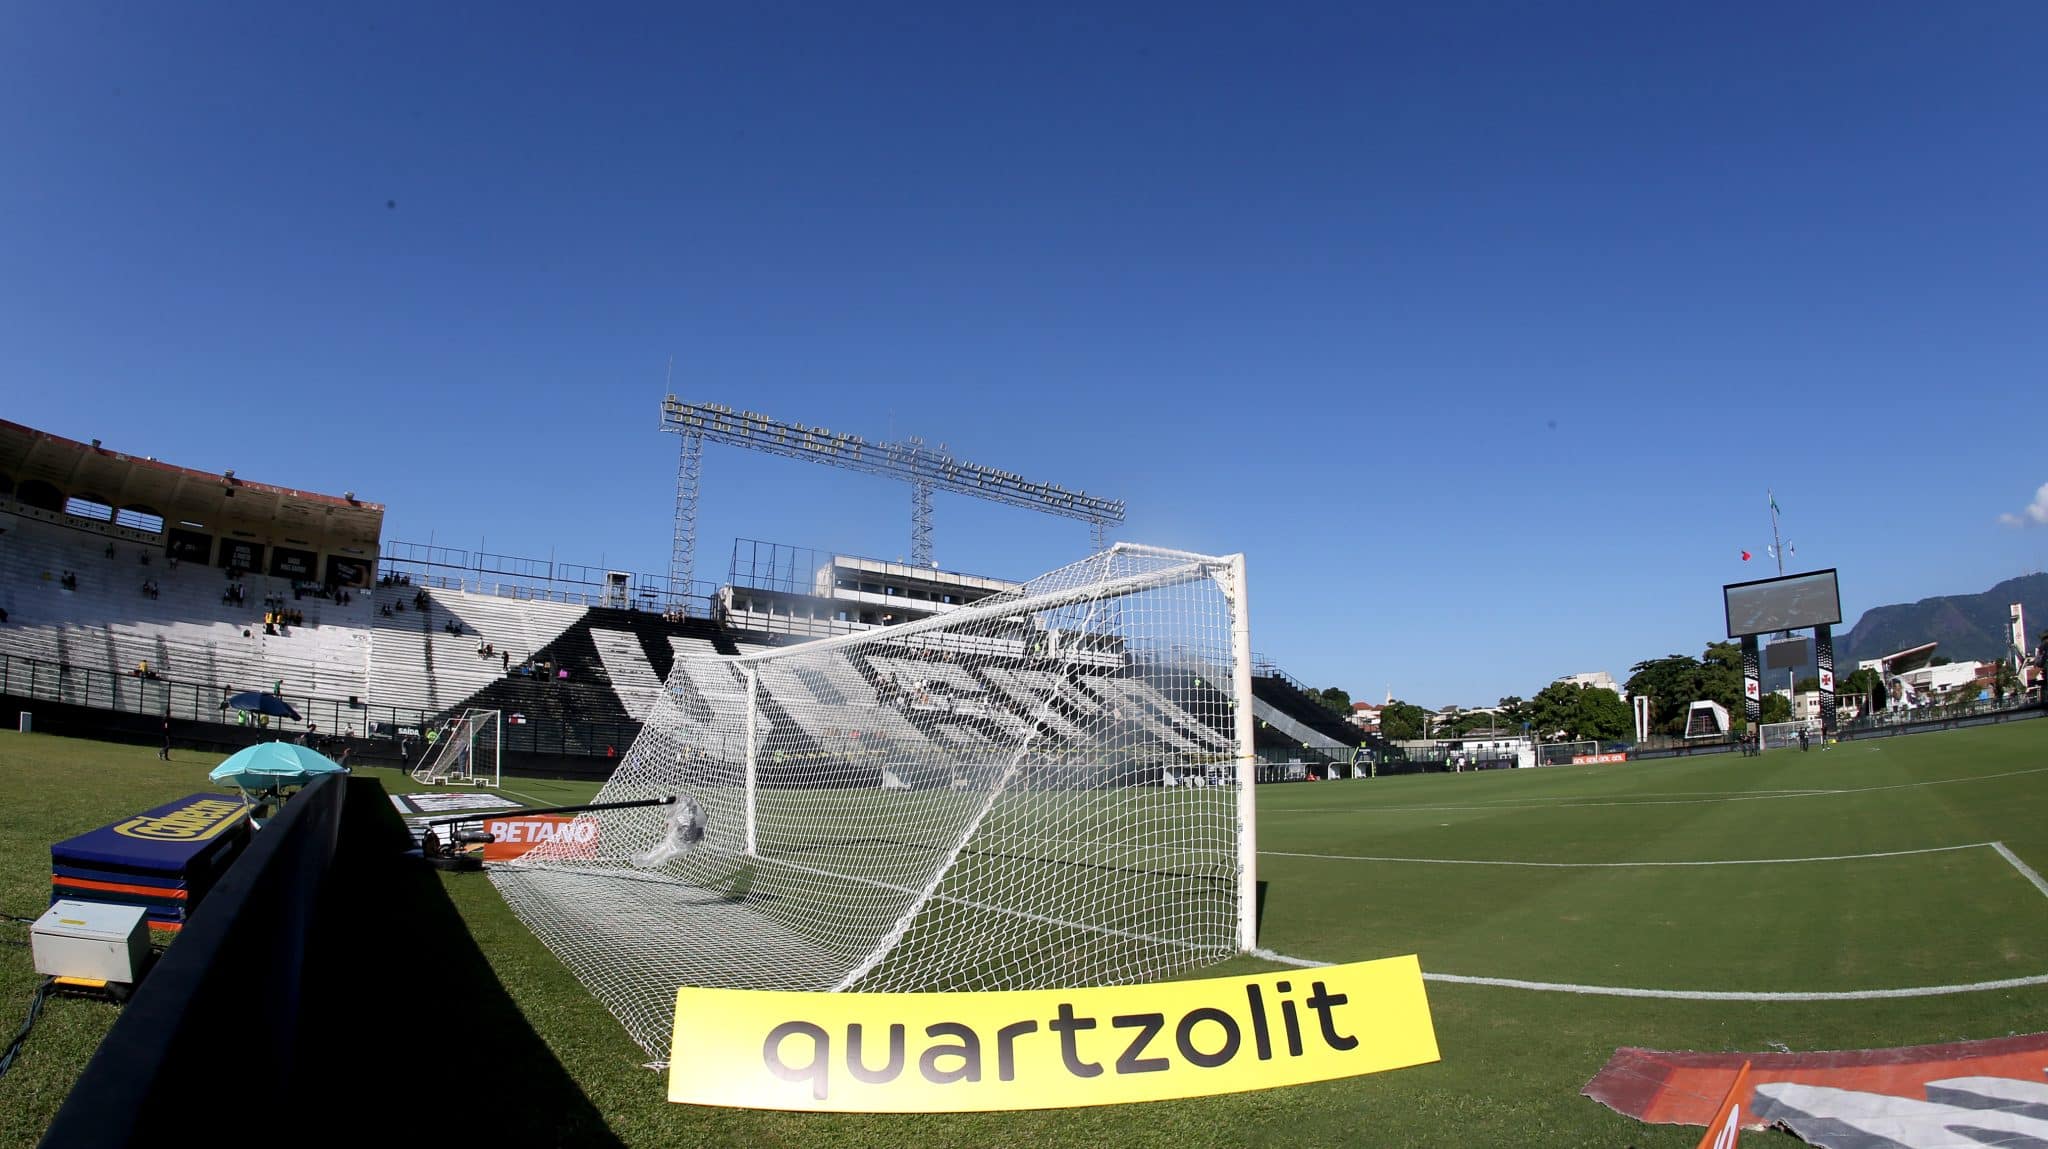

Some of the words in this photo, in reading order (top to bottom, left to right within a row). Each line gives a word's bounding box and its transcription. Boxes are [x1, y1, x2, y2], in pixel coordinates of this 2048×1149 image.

[398, 727, 420, 736] SAÍDA
[490, 821, 596, 843] BETANO
[763, 981, 1359, 1100] quartzolit
